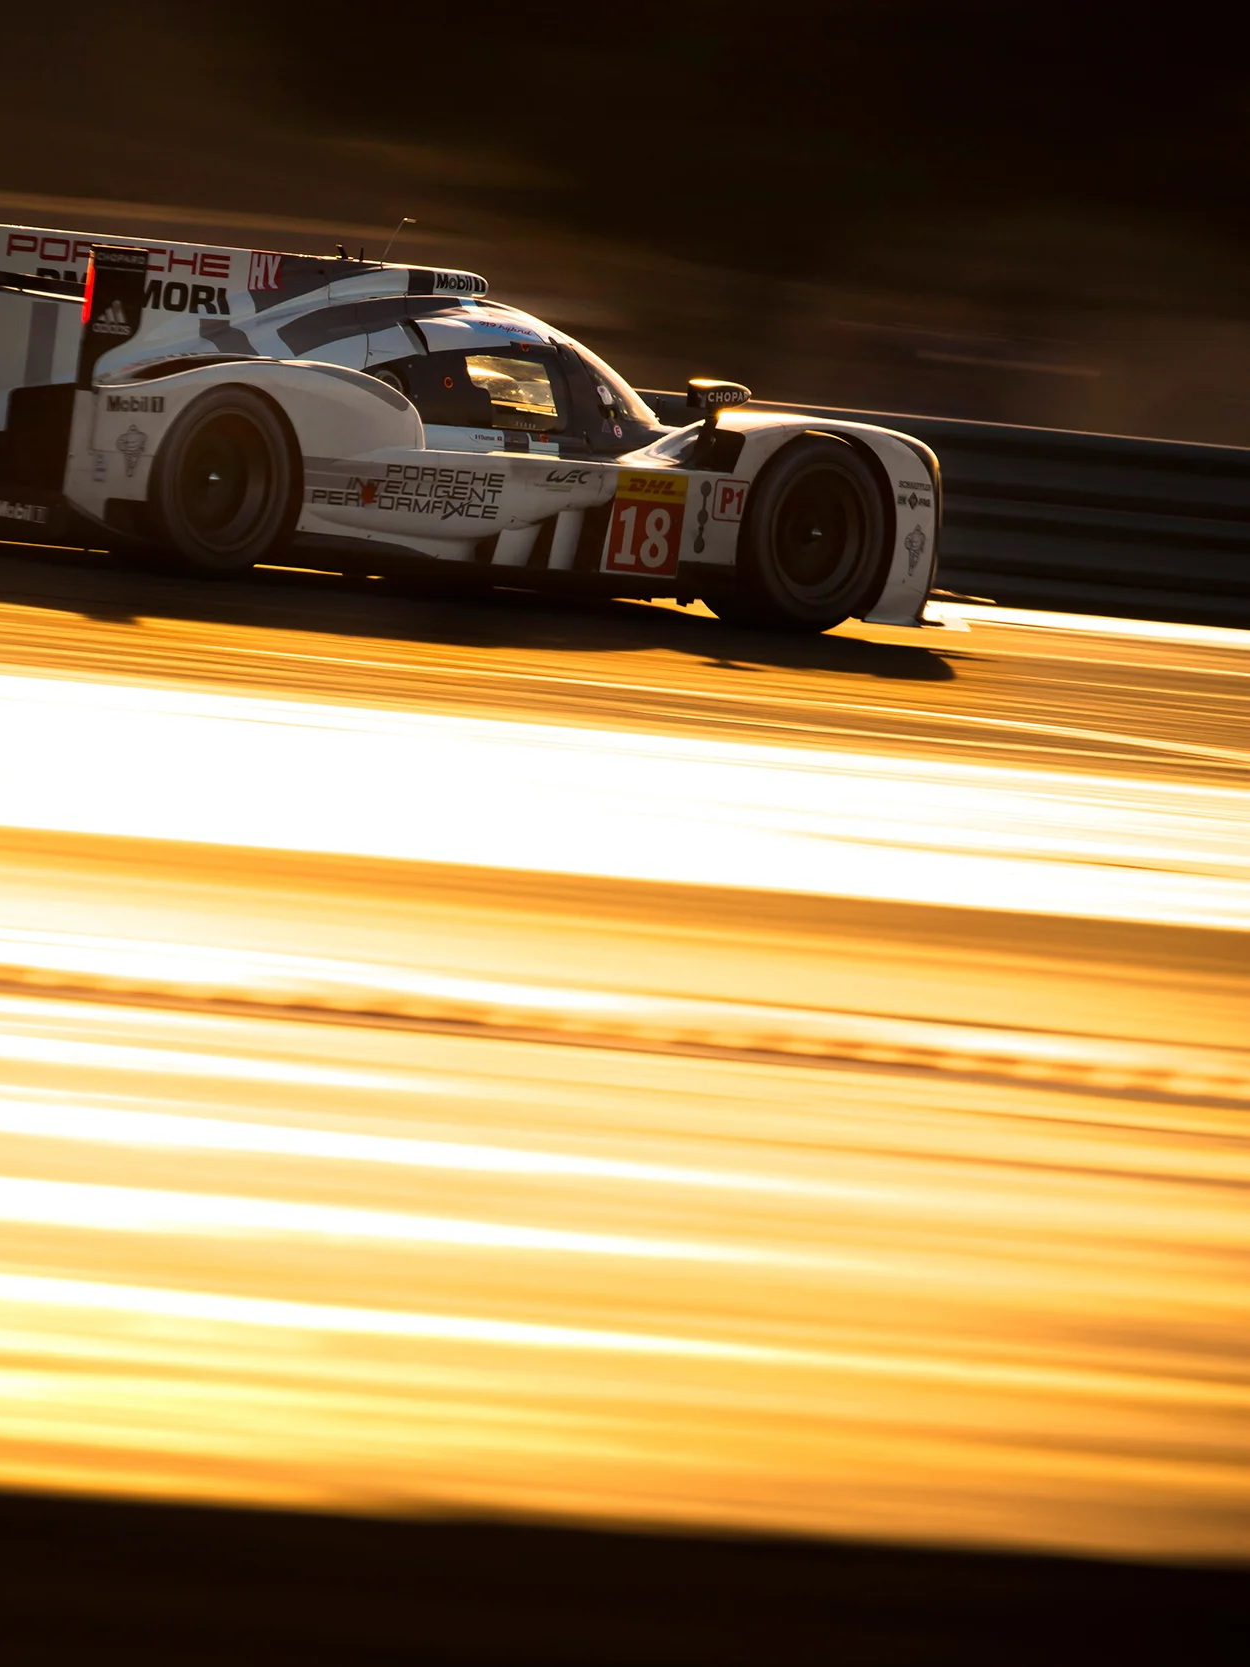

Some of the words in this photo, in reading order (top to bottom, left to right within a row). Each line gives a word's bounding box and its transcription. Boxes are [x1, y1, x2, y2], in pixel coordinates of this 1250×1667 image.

[6, 233, 231, 278] PORCHE
[250, 253, 283, 291] HY
[436, 273, 473, 291] Mobil
[106, 395, 149, 413] Mobil
[386, 464, 505, 489] PORSCHE
[546, 470, 592, 485] WEC
[628, 478, 675, 497] DHL
[346, 476, 502, 504] INTELLIGENT
[720, 487, 745, 515] P1
[614, 505, 671, 568] 18
